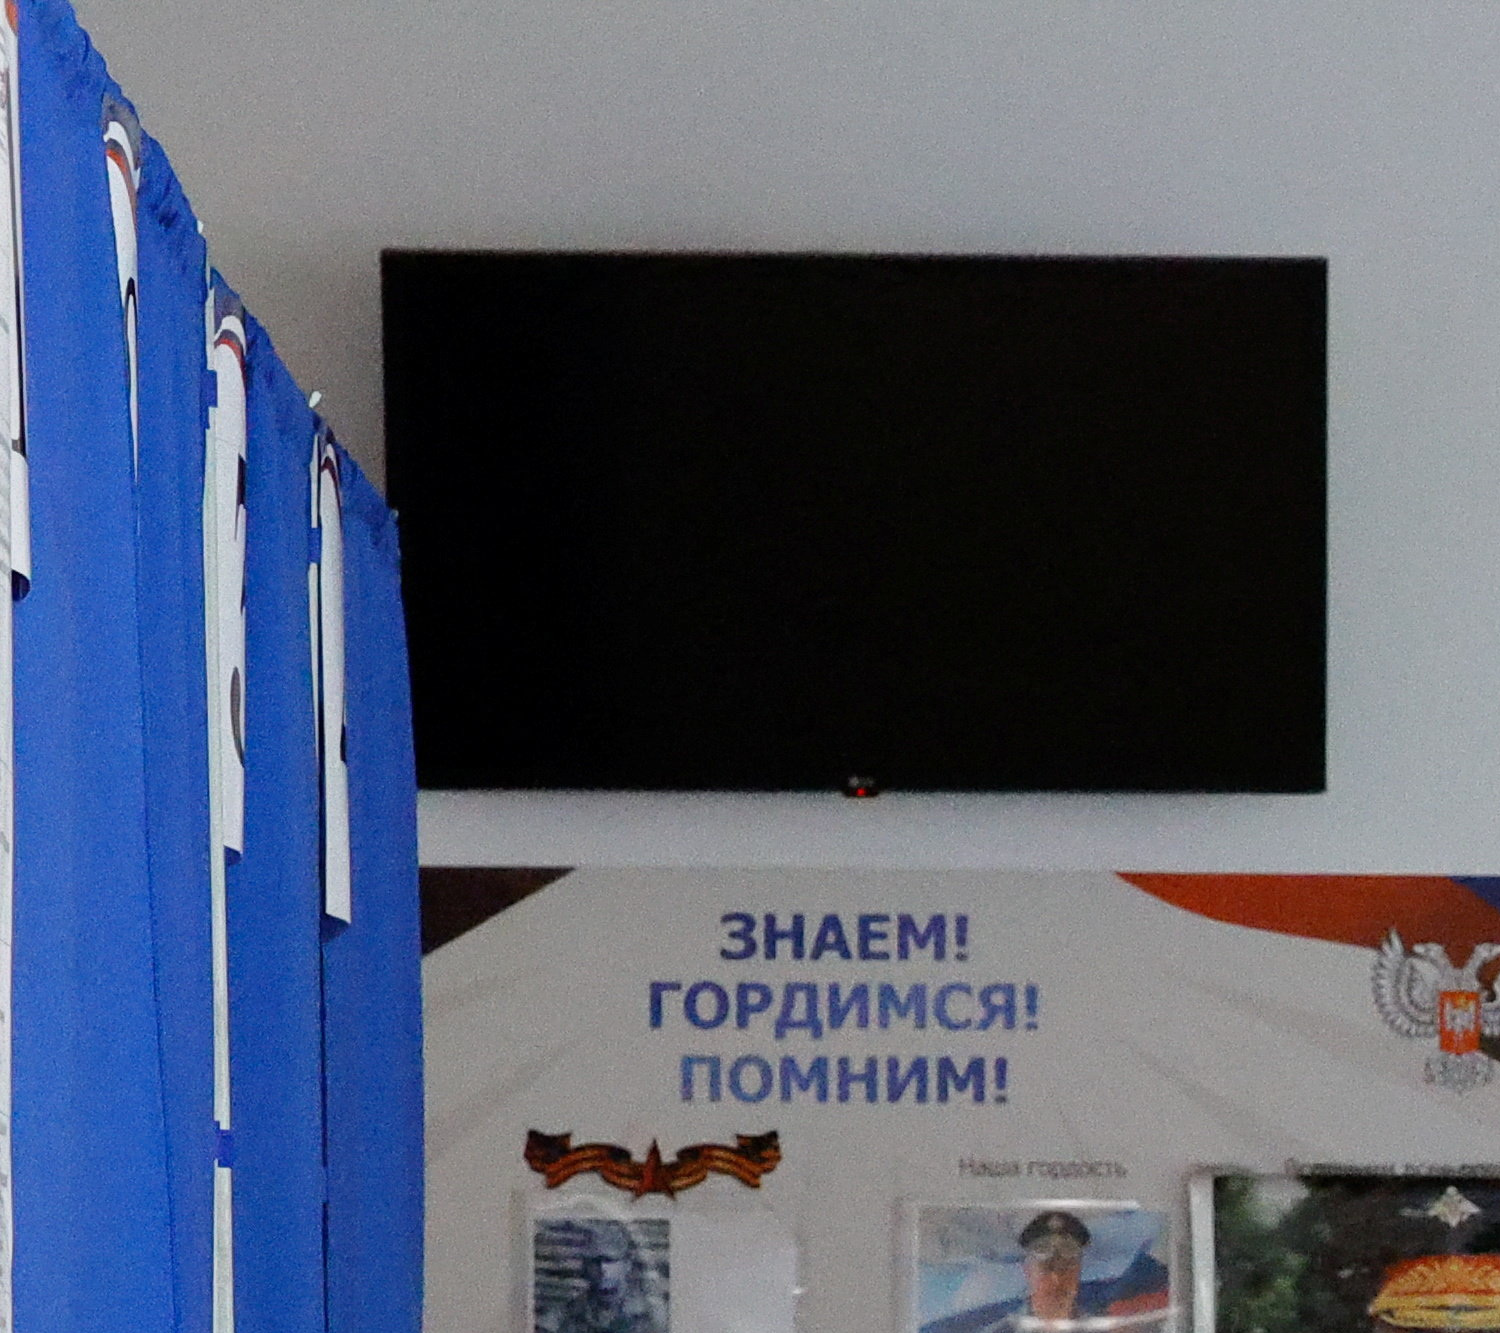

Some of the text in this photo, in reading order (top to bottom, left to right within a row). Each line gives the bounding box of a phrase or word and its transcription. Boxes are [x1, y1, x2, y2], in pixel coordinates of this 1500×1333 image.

[718, 911, 972, 962] ЗНАЕМ!
[647, 978, 1041, 1035] ГОРДИМСЯ!
[679, 1053, 1010, 1105] ПОМНИМ!
